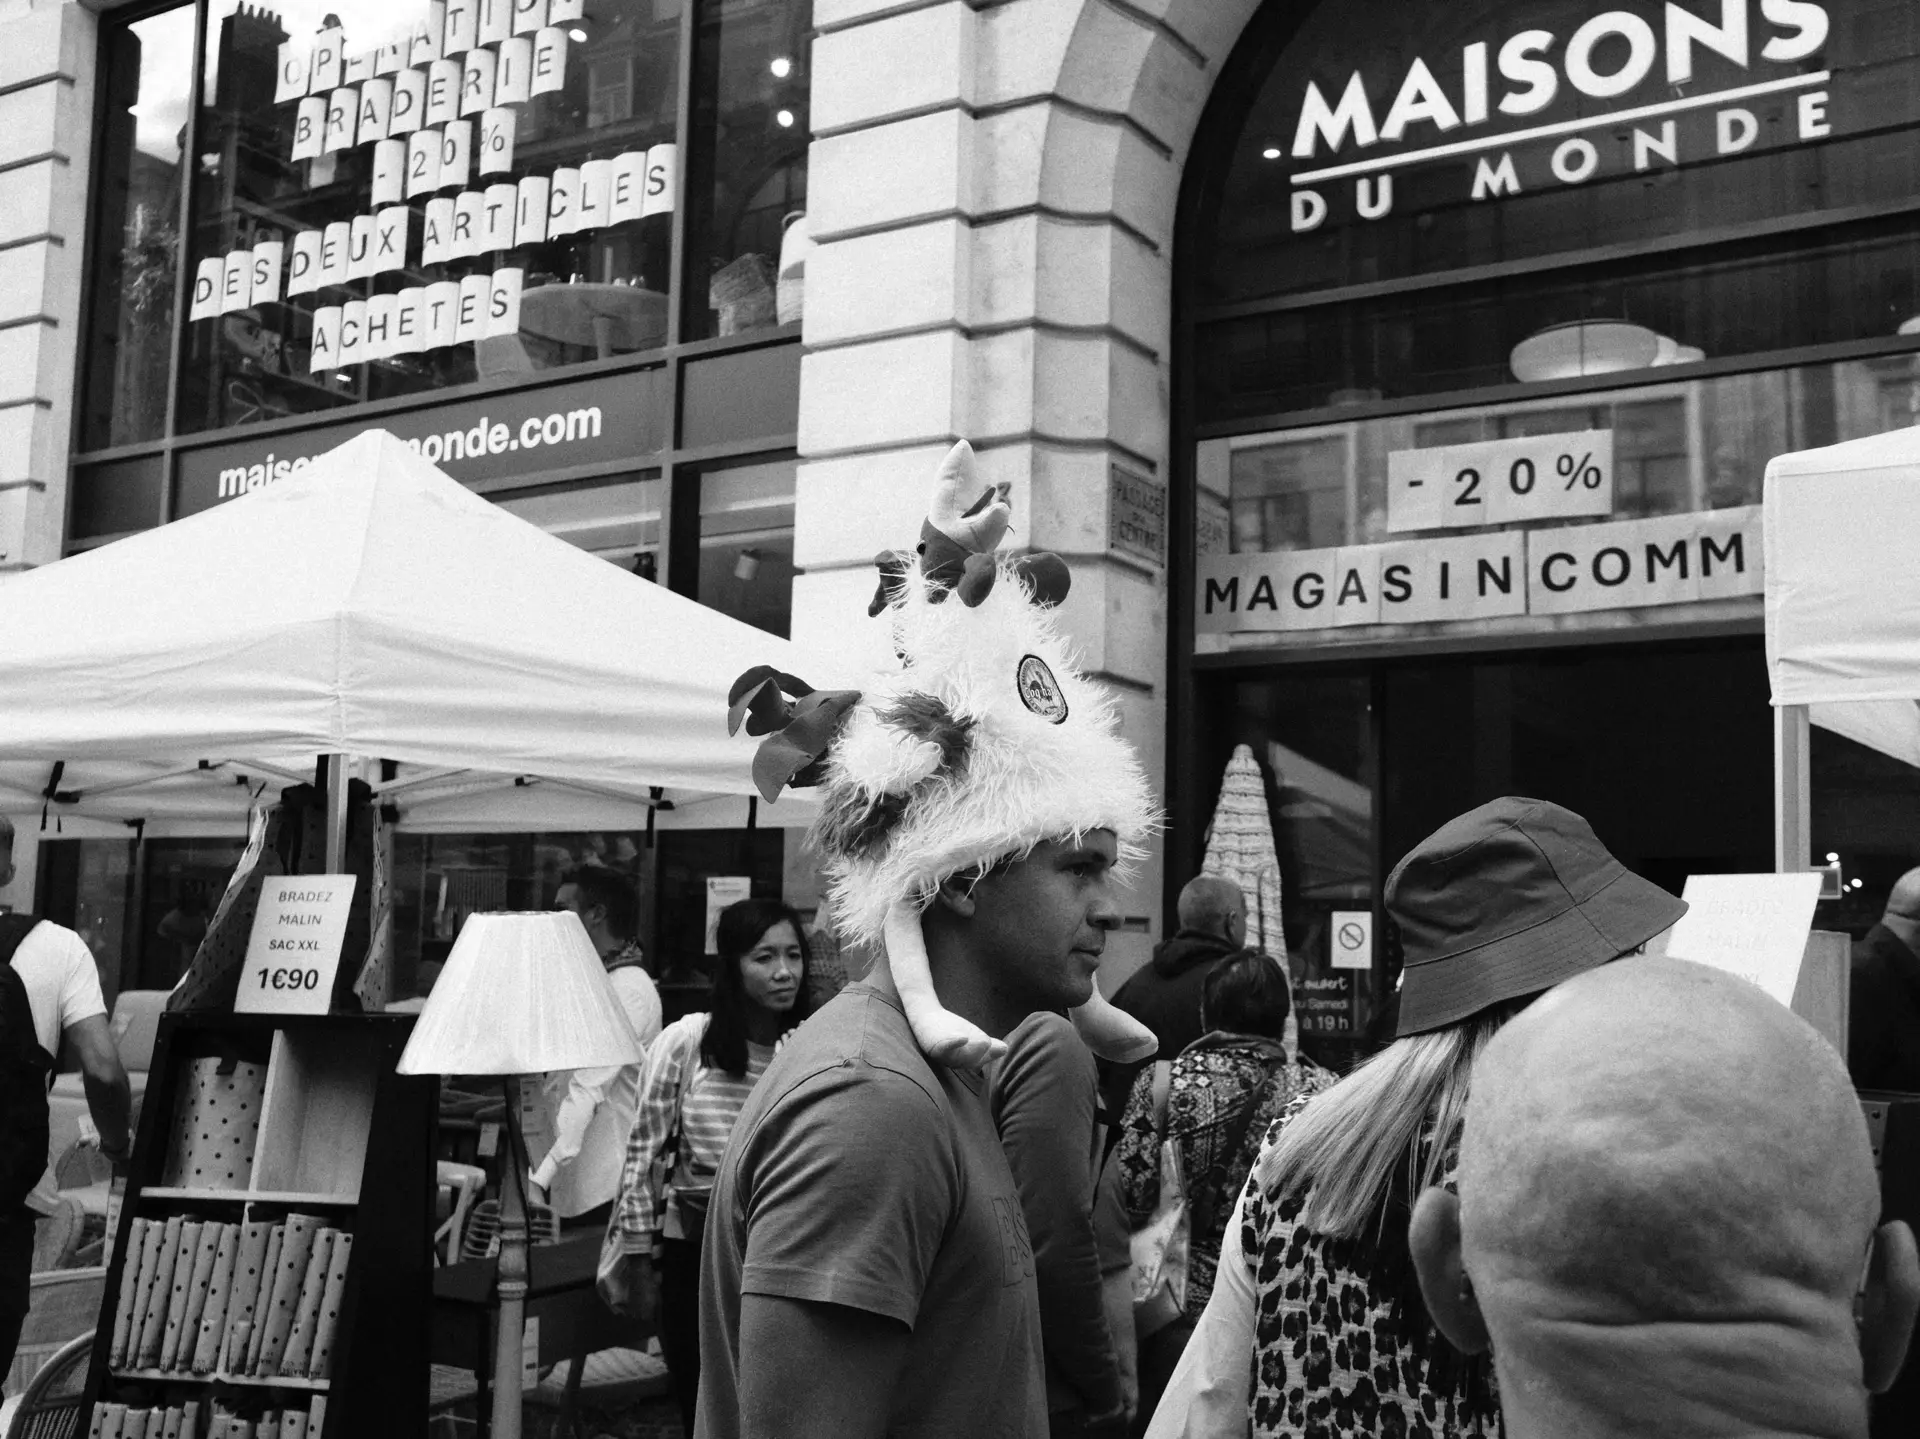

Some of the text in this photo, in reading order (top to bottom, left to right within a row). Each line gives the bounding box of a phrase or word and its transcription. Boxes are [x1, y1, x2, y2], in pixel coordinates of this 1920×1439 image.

[297, 46, 554, 144] BRADERIE
[1291, 0, 1830, 157] MAISONS
[1291, 91, 1832, 232] DU MONDE
[197, 164, 667, 302] DES DEUX ARTICLES
[313, 289, 509, 354] ACHETES
[1204, 556, 1512, 614] MAGASIN
[278, 890, 334, 903] BRADEZ
[278, 914, 323, 925] MALIN
[269, 939, 321, 951] SAC XXL
[258, 967, 319, 991] 1€90
[1317, 1015, 1336, 1032] 19
